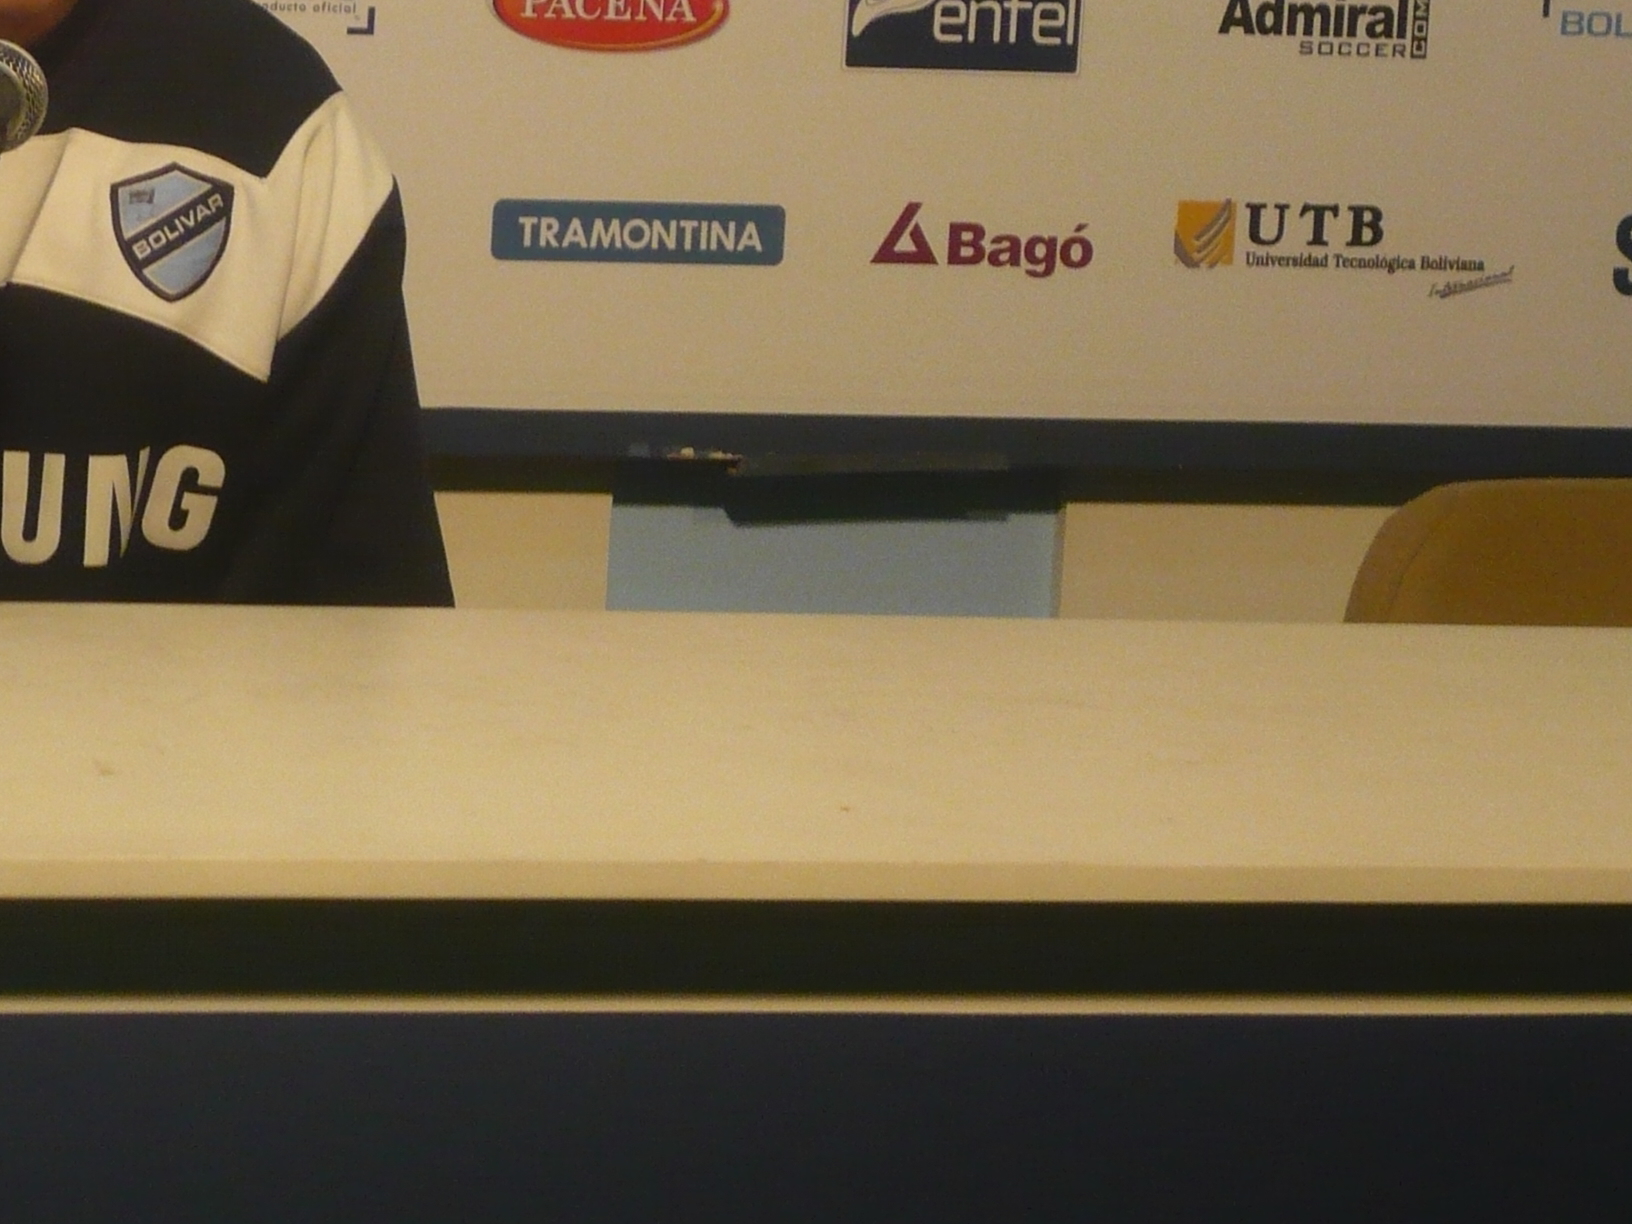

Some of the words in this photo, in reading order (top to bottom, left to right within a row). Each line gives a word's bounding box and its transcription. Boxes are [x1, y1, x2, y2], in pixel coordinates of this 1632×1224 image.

[1299, 40, 1408, 60] SOCCER
[132, 193, 224, 260] BOLIVAR
[518, 215, 763, 254] TRAMONTINA
[1244, 202, 1385, 247] UTB
[946, 221, 1095, 279] Bagó
[1245, 250, 1329, 268] Universidad
[1334, 253, 1416, 275] Tecnológica
[1421, 254, 1485, 272] Boliviana
